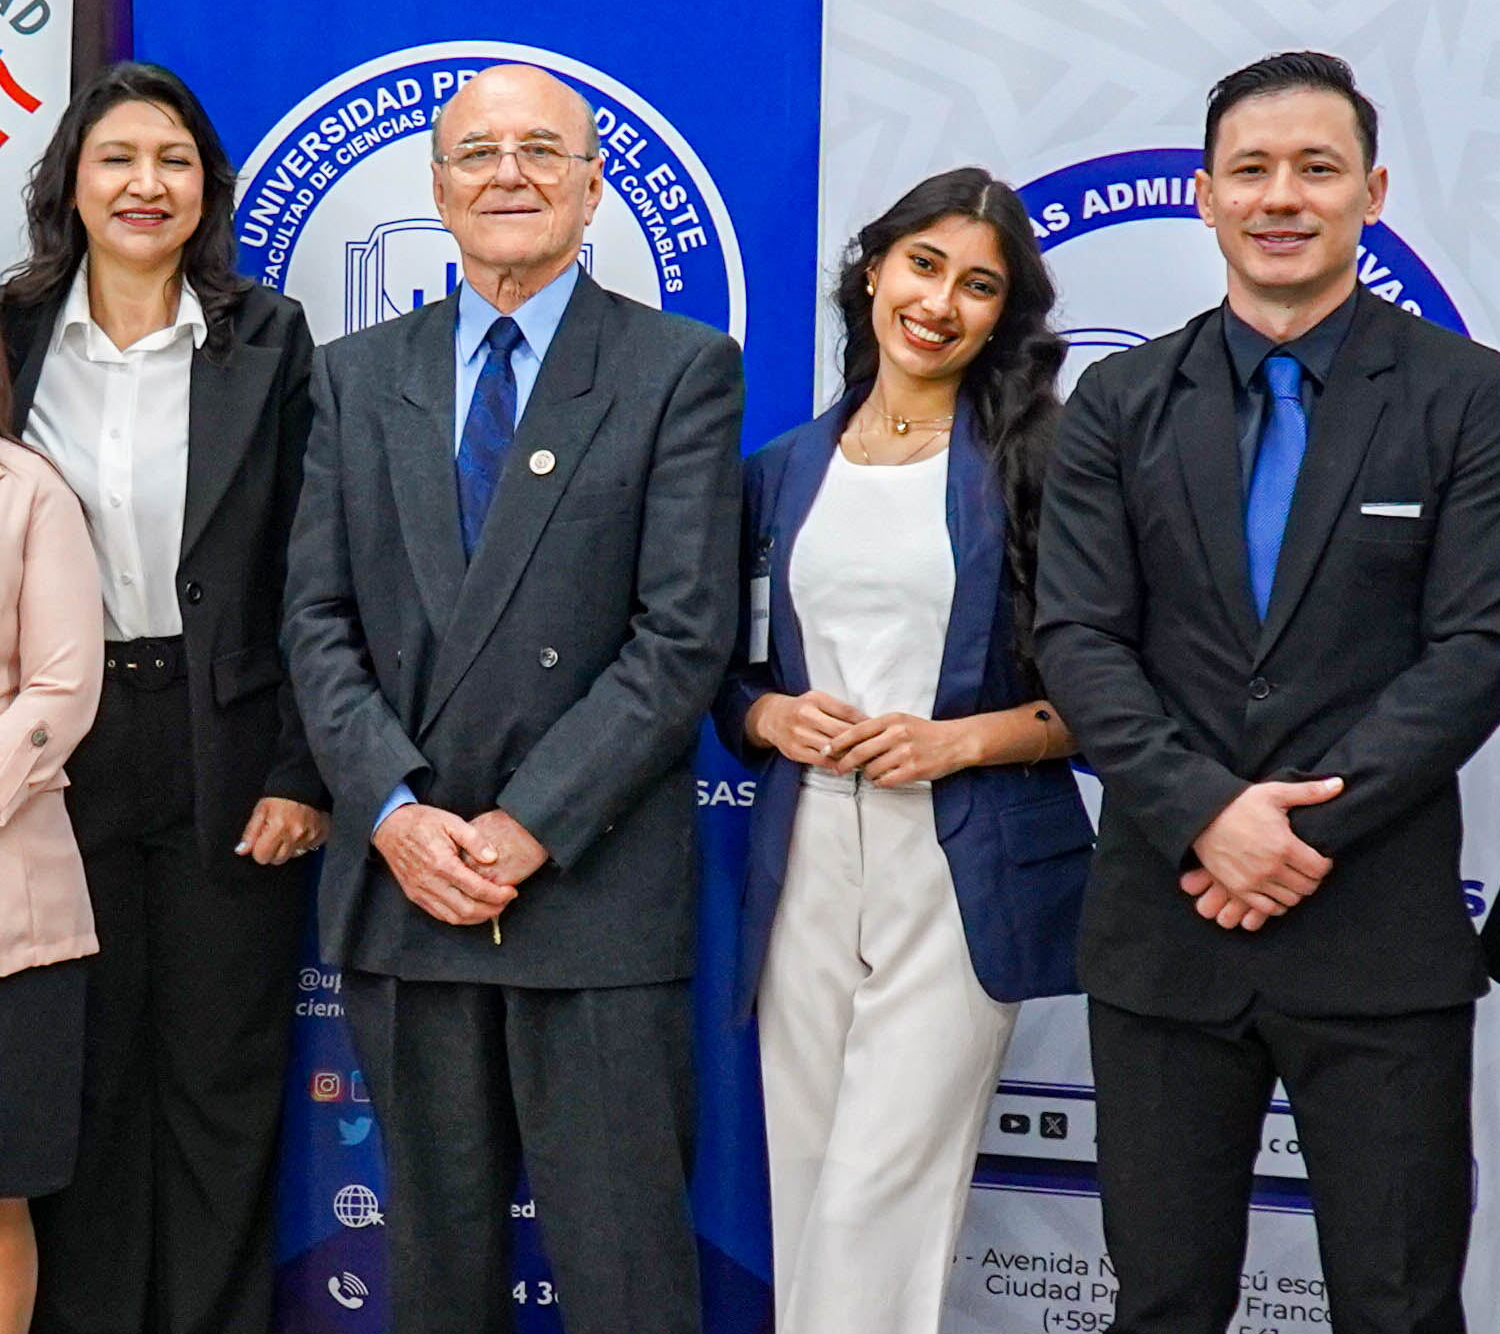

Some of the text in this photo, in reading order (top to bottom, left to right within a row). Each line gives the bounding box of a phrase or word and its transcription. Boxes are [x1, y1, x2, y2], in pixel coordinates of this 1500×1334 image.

[239, 77, 423, 249] UNIVERSIDAD
[262, 108, 427, 290] FACULTAD DE CIENCIAS
[594, 106, 708, 253] DEL ESTE
[609, 158, 684, 293] Y CONTABLES
[982, 1247, 1090, 1277] Avenida
[986, 1274, 1081, 1303] Ciudad
[1043, 1307, 1113, 1334] (+595
